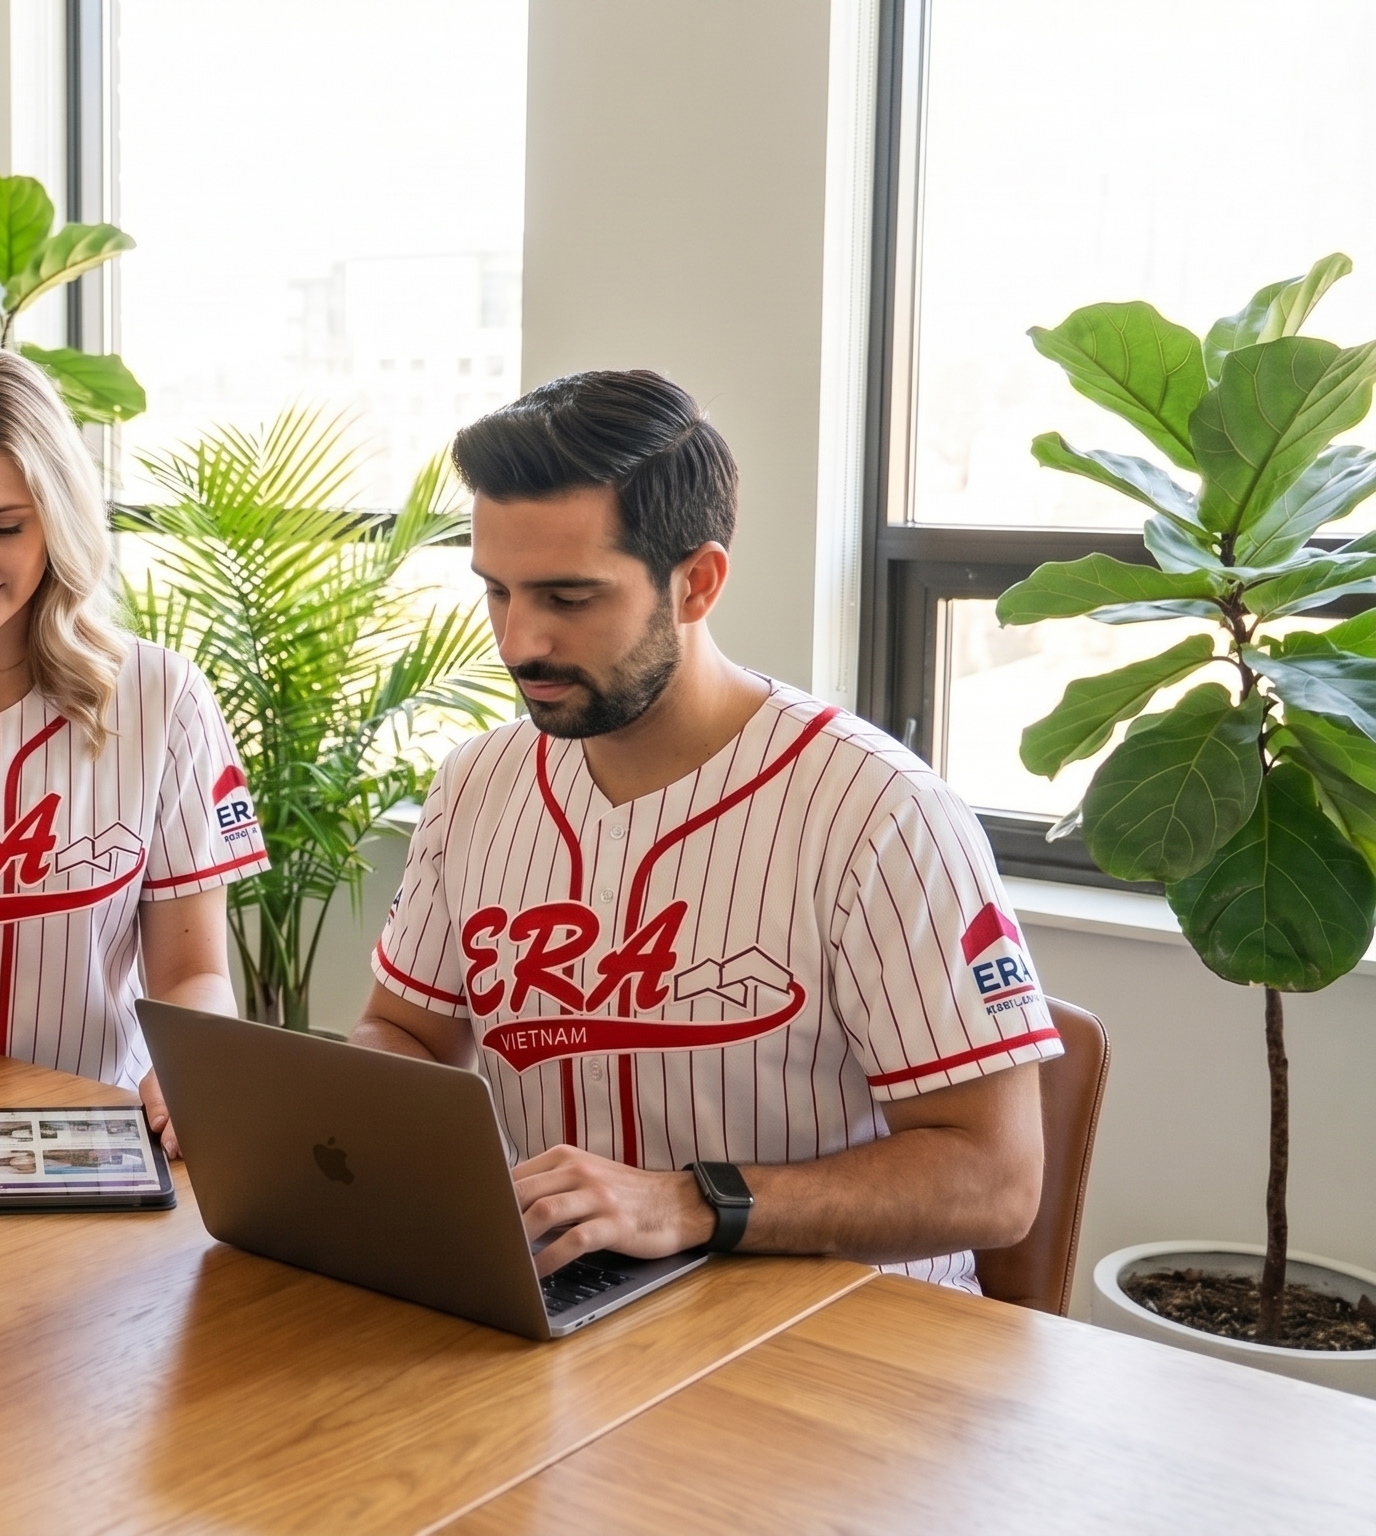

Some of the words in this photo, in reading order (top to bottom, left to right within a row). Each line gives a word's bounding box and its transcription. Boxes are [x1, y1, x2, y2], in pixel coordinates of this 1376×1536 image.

[216, 801, 257, 828] ER
[461, 900, 689, 1018] ERA
[501, 1027, 587, 1051] VIETNAM
